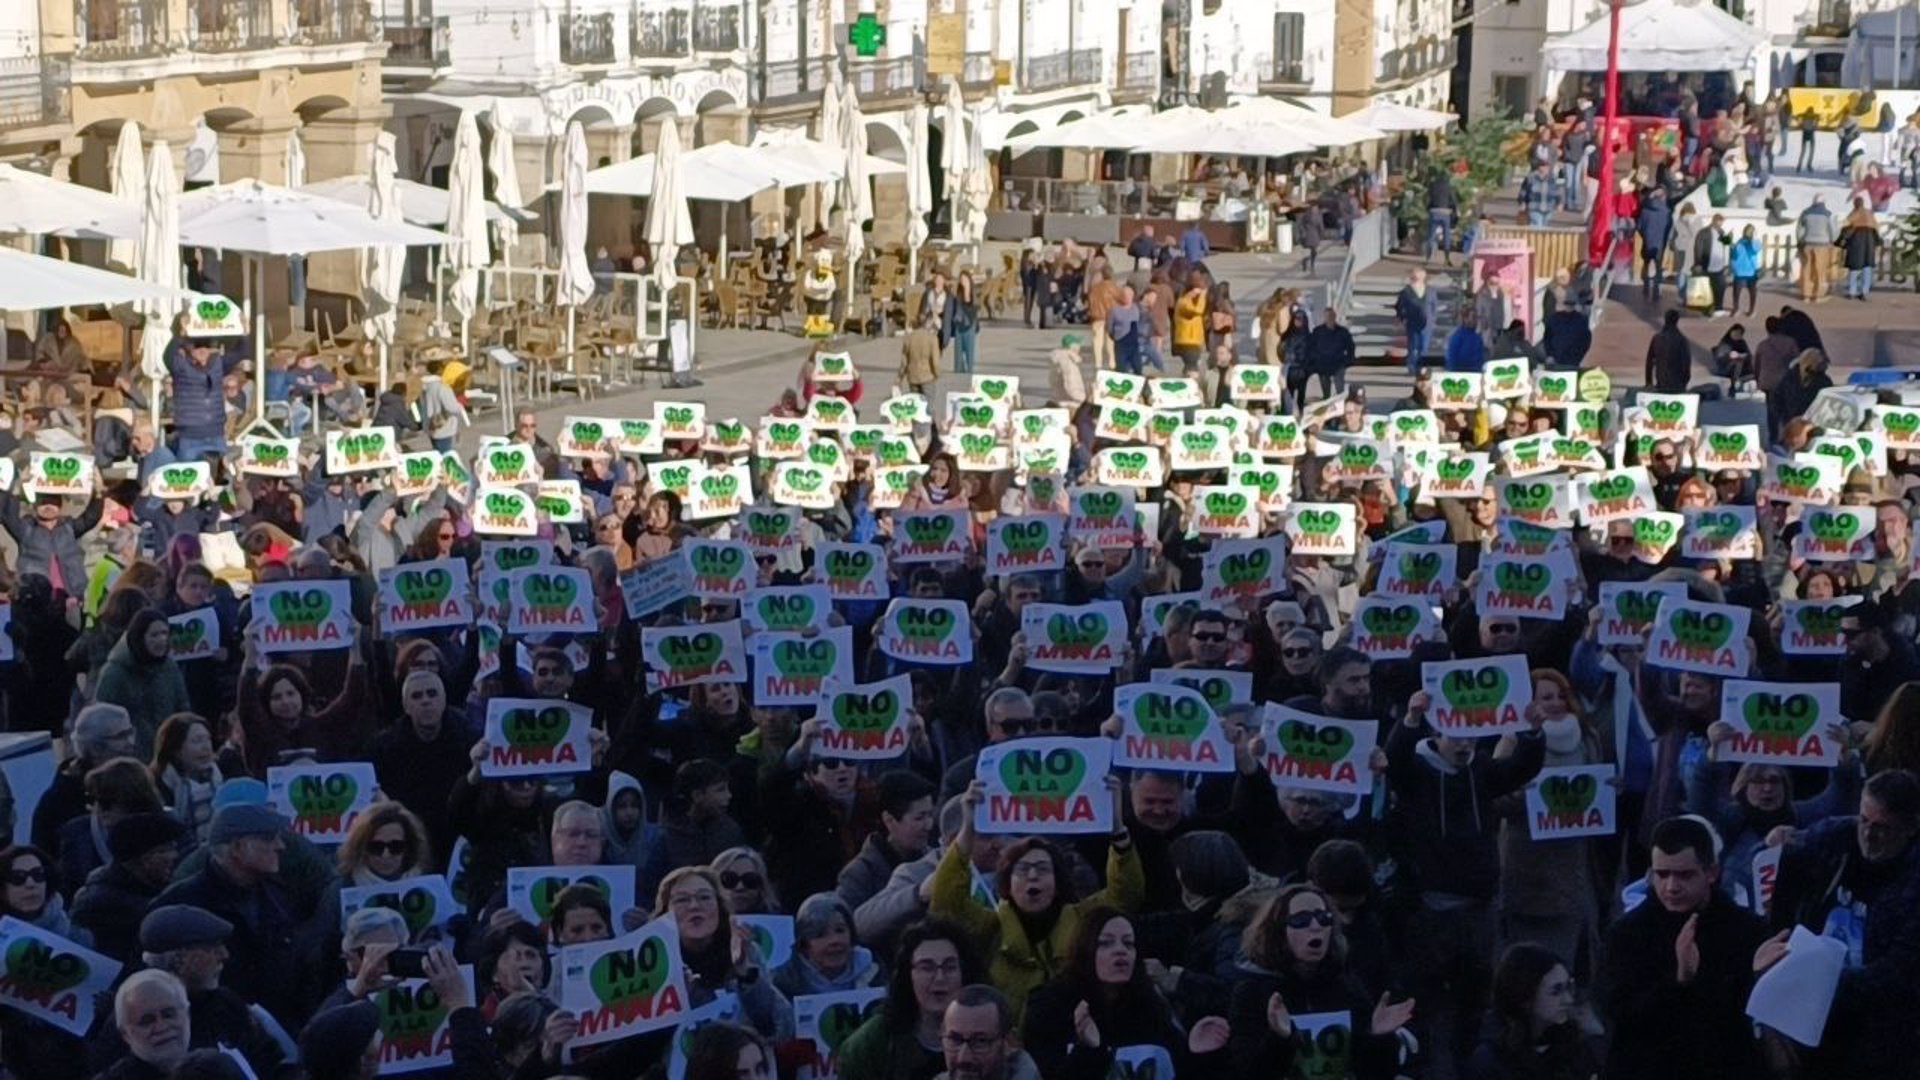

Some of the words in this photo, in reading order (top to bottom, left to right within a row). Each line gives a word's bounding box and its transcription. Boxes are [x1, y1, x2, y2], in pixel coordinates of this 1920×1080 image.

[1654, 400, 1681, 413] NO
[1714, 431, 1744, 446] NO
[493, 451, 522, 465] NO
[1344, 445, 1372, 459] NO
[1442, 457, 1473, 473] NO
[1784, 464, 1815, 479] NO
[1512, 483, 1546, 499] NO
[1598, 474, 1628, 492] NO
[1088, 491, 1116, 506] NO
[1212, 493, 1240, 507] NO
[1588, 495, 1646, 518] MINA
[755, 512, 786, 527] NO
[914, 514, 947, 531] NO
[1200, 515, 1251, 529] MINA
[1305, 510, 1336, 524] NO
[1641, 517, 1671, 535] NO
[1819, 512, 1850, 528] NO
[1010, 520, 1041, 538] NO
[1292, 533, 1346, 548] MINA
[502, 546, 533, 561] NO
[702, 546, 737, 565] NO
[834, 550, 866, 567] NO
[997, 547, 1056, 567] MINA
[1227, 548, 1265, 573] NO
[1410, 551, 1437, 568] NO
[405, 568, 444, 589] NO
[1506, 561, 1543, 581] NO
[534, 574, 570, 593] NO
[1387, 577, 1444, 597] MINA
[282, 589, 322, 608] NO
[769, 594, 806, 612] NO
[1487, 590, 1554, 611] MINA
[391, 600, 461, 622] MINA
[518, 606, 584, 625] MINA
[907, 607, 947, 626] NO
[1373, 605, 1412, 622] NO
[1058, 612, 1100, 633] NO
[1681, 611, 1725, 633] NO
[265, 623, 341, 643] MINA
[671, 632, 714, 654] NO
[786, 639, 828, 660] NO
[890, 637, 960, 658] MINA
[1036, 644, 1112, 661] MINA
[1660, 639, 1736, 668] MINA
[1454, 666, 1499, 690] NO
[845, 690, 890, 715] NO
[1150, 694, 1198, 721] NO
[1757, 694, 1809, 719] NO
[514, 706, 561, 730] NO
[1436, 703, 1519, 728] MINA
[822, 727, 904, 750] MINA
[1292, 722, 1344, 746] NO
[493, 742, 577, 767] MINA
[1126, 735, 1218, 764] MINA
[1731, 732, 1824, 757] MINA
[1015, 748, 1074, 776] NO
[1267, 752, 1357, 784] MINA
[302, 773, 348, 797] NO
[1020, 780, 1029, 792] A
[1036, 779, 1059, 791] LA
[1553, 773, 1590, 794] NO
[990, 795, 1096, 823] MINA
[1537, 807, 1604, 831] MINA
[609, 939, 659, 984] NO
[389, 982, 441, 1015] NO
[577, 984, 682, 1037] MINA
